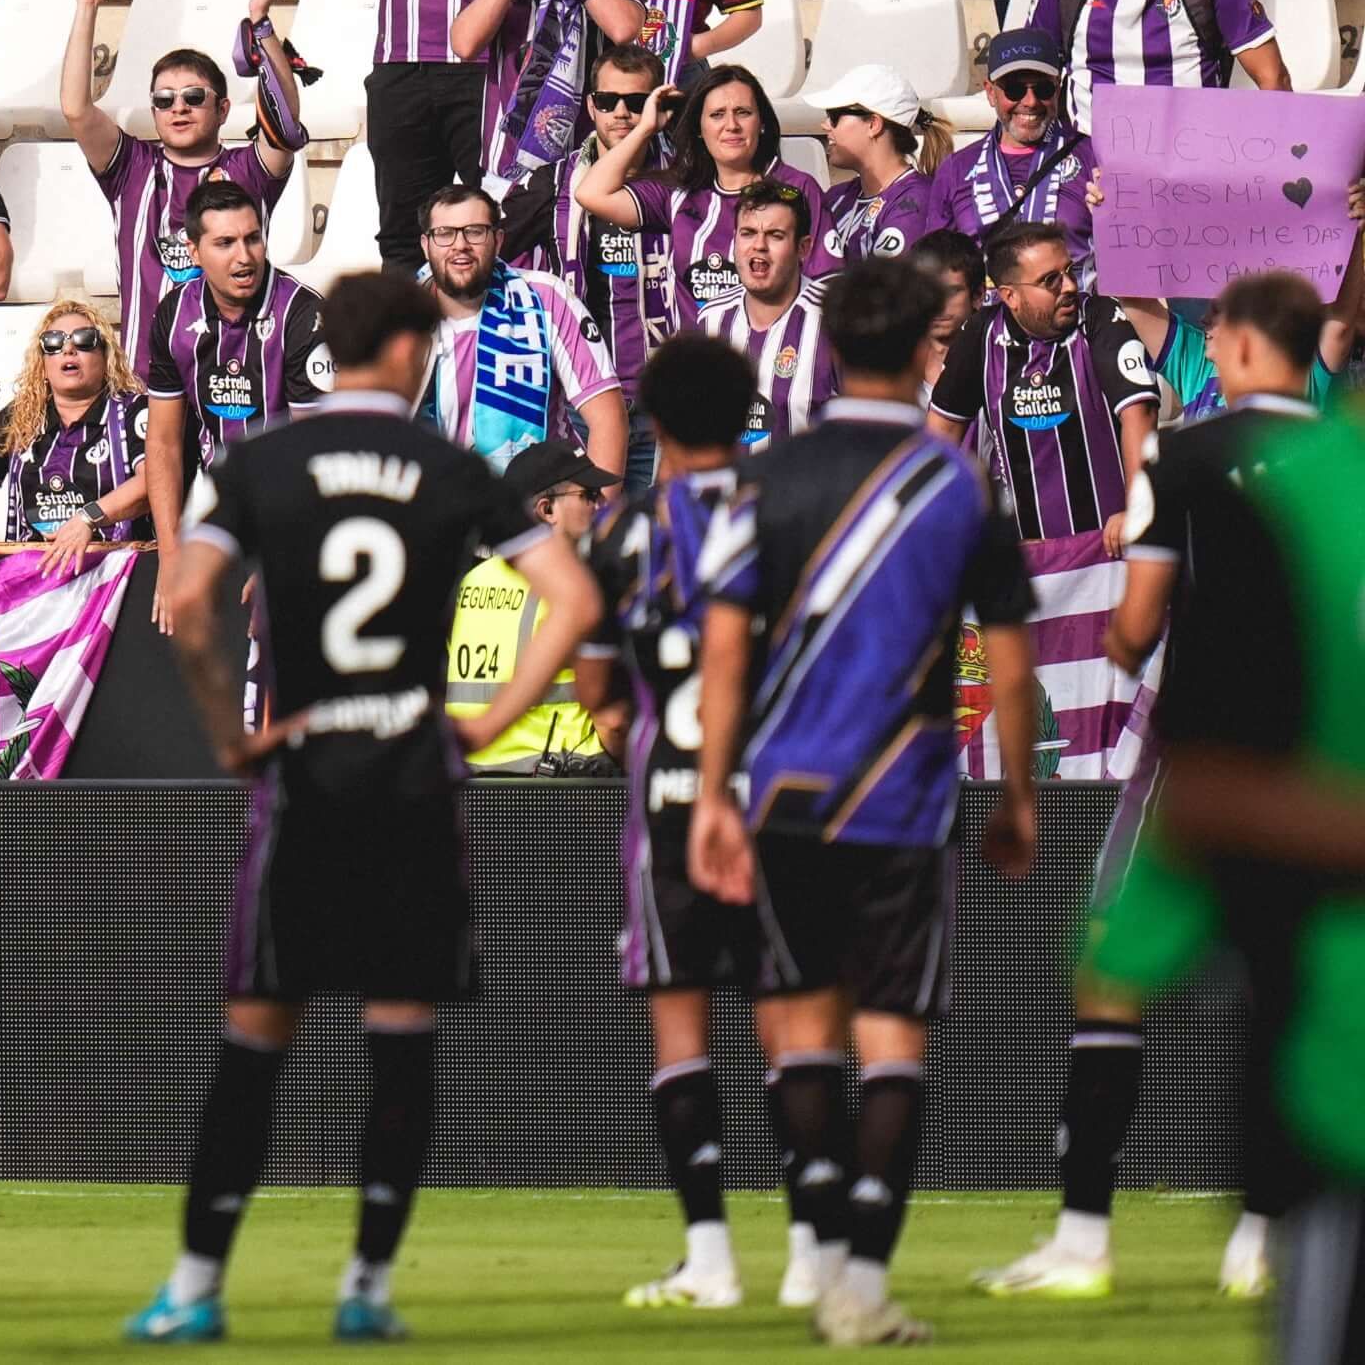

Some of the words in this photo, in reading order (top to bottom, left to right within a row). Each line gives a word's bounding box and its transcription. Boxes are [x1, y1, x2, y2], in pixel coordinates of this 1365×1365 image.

[1111, 115, 1276, 164] ALEJO
[1249, 225, 1294, 246] ME
[1303, 224, 1343, 246] DAS
[690, 269, 740, 286] Estrella
[1147, 264, 1191, 287] TU
[1206, 257, 1330, 284] CAMTA
[208, 374, 252, 391] Estrella
[208, 388, 252, 406] Galicia
[1013, 384, 1062, 401] Estrella
[1014, 398, 1062, 415] Galicia
[35, 491, 84, 507] Estrella
[317, 517, 407, 676] 2
